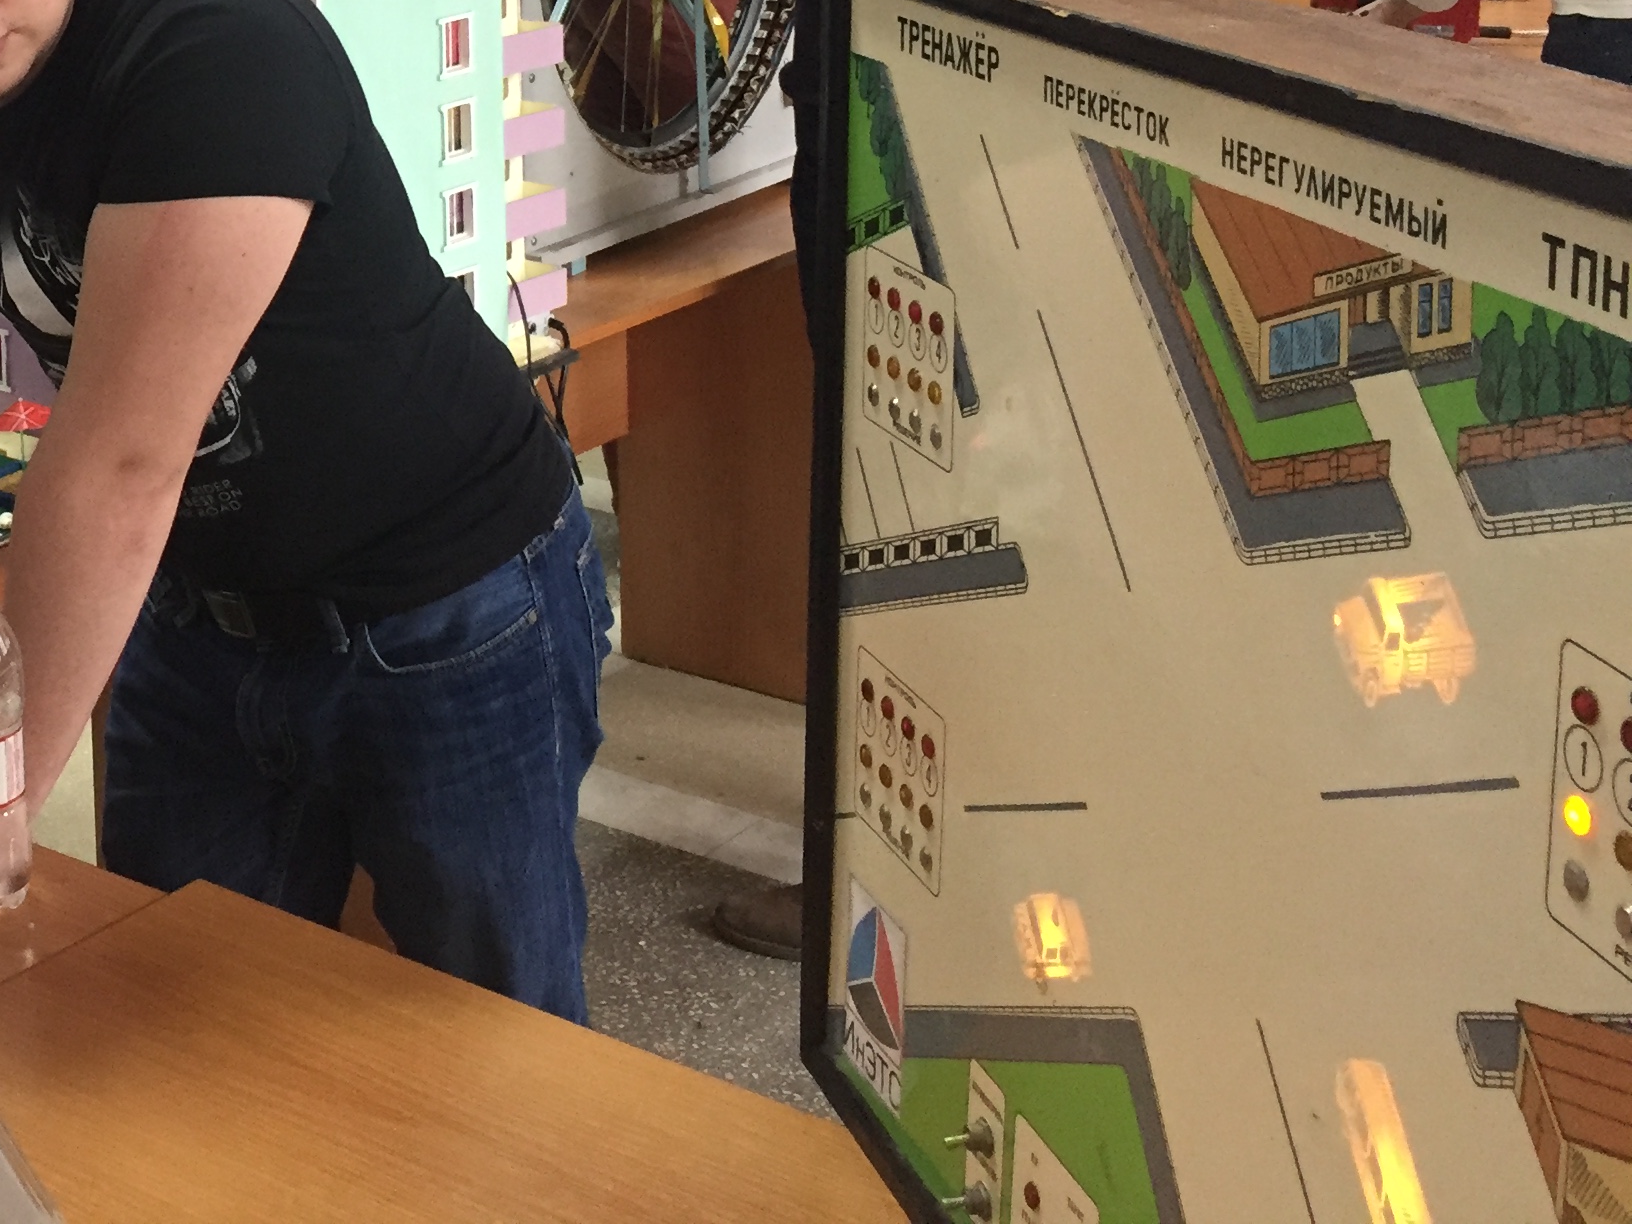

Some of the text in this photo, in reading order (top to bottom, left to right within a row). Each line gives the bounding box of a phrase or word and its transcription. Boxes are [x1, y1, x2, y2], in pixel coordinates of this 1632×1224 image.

[897, 16, 1630, 319] ТРЕНАЖЁР ПЕРЕКРЁСТОК НЕРЕГУЛИРУЕМЫЙ ТПН
[1324, 257, 1404, 291] ПРОДУКТЫ
[893, 314, 899, 339] 2
[915, 327, 921, 352] 3
[935, 339, 942, 364] 4
